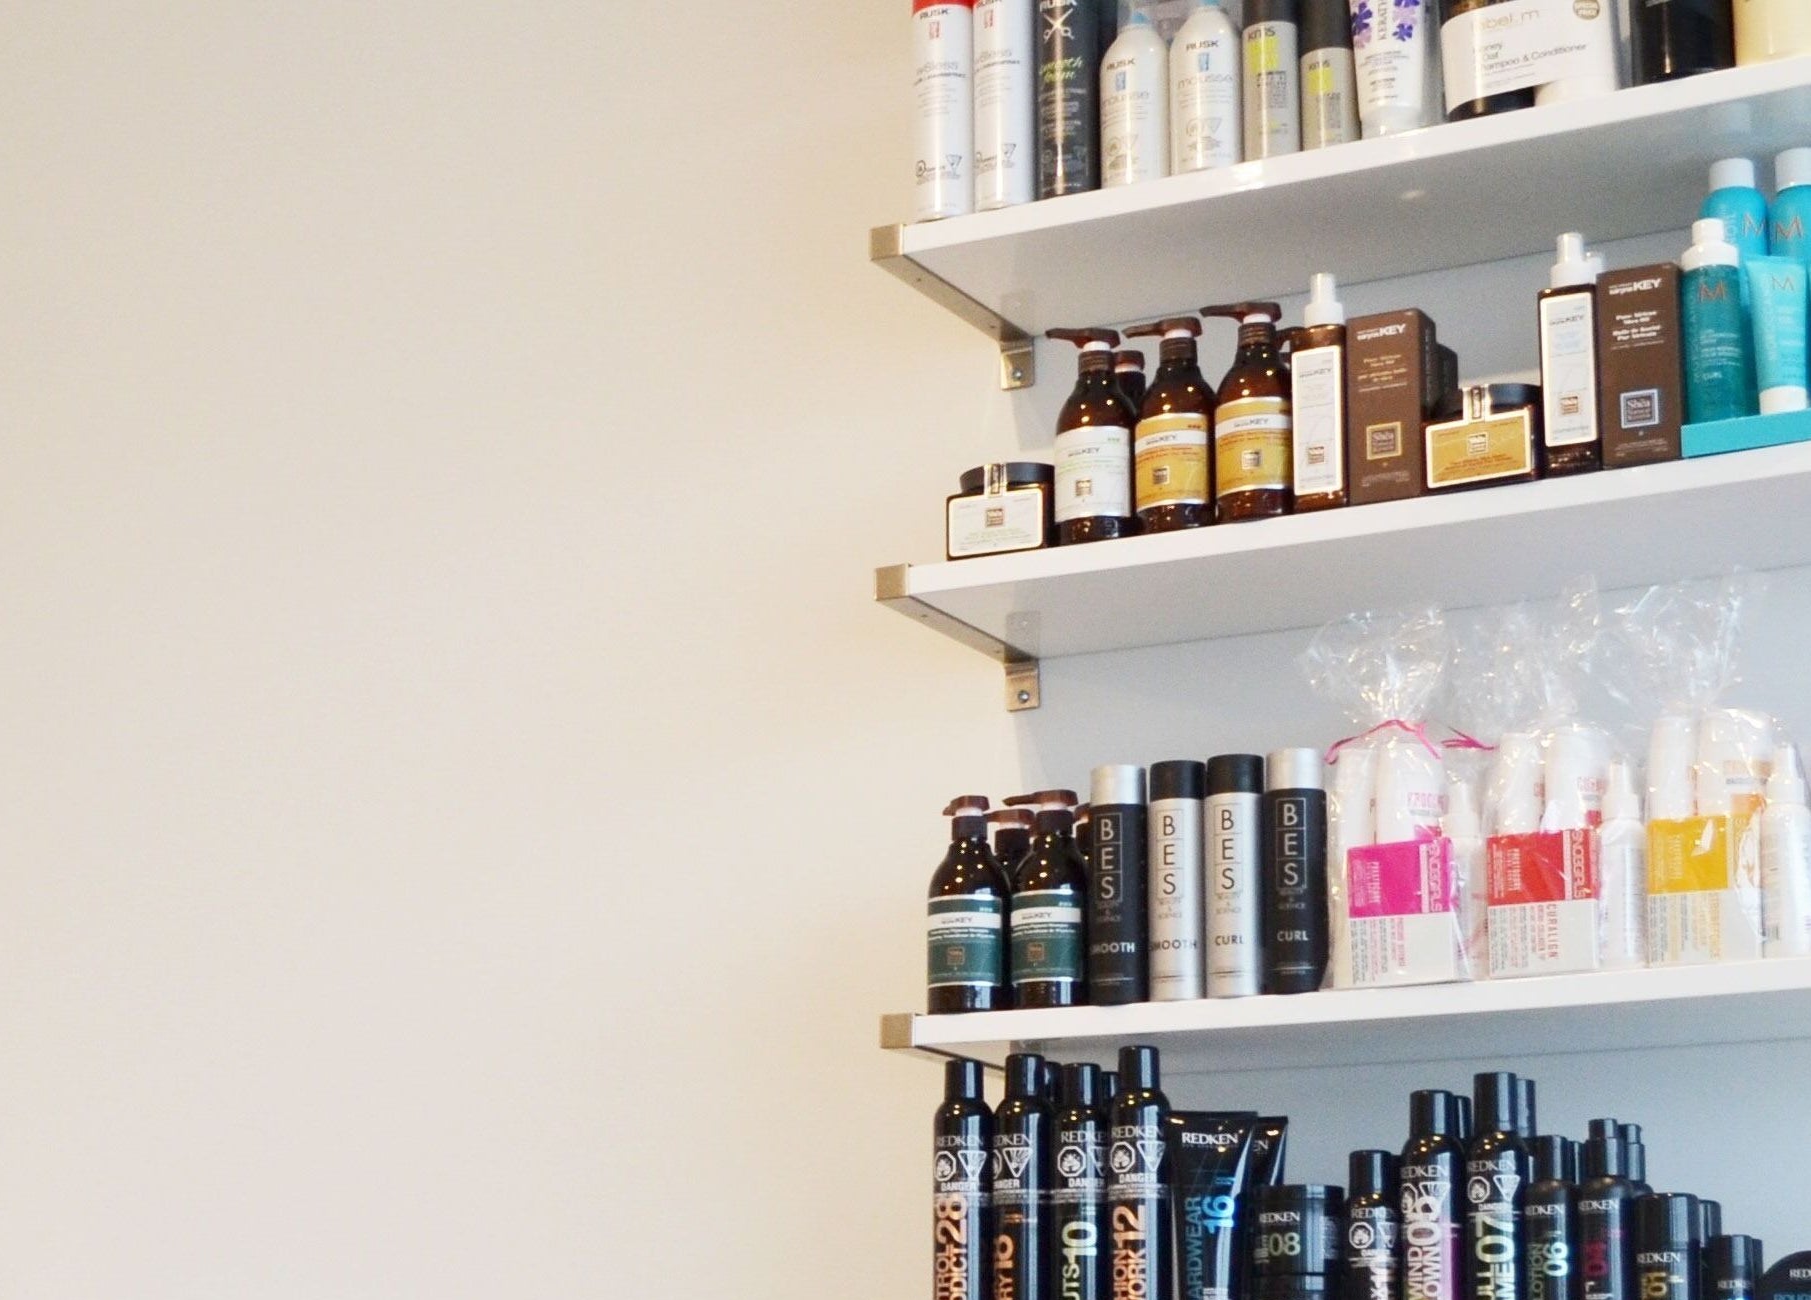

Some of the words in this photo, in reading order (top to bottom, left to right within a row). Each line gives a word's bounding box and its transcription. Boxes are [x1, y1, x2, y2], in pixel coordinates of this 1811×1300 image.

[919, 8, 949, 19] RUSK
[1186, 39, 1219, 50] RUSK
[1531, 43, 1587, 61] Conditioner
[1106, 57, 1136, 70] RUSK
[1221, 809, 1235, 890] BES
[1283, 803, 1299, 886] BES
[1100, 818, 1115, 900] BES
[1162, 814, 1177, 896] BES
[1214, 935, 1245, 946] CURL
[1277, 930, 1310, 942] CURL
[1111, 1126, 1164, 1139] REDKEN
[1181, 1132, 1239, 1146] REDKEN
[1467, 1159, 1517, 1173] REDKEN
[941, 1181, 978, 1193] DANGER
[1119, 1173, 1157, 1184] DANGER
[937, 1192, 968, 1246] 28
[1201, 1194, 1235, 1235] 16
[1259, 1211, 1301, 1224] REDKEN
[1112, 1204, 1147, 1251] 12
[1062, 1221, 1097, 1262] 10
[1268, 1232, 1302, 1257] 08
[1475, 1211, 1515, 1264] 07
[995, 1233, 1015, 1269] 10
[1543, 1241, 1569, 1277] 06
[1637, 1251, 1681, 1264] REDKEN
